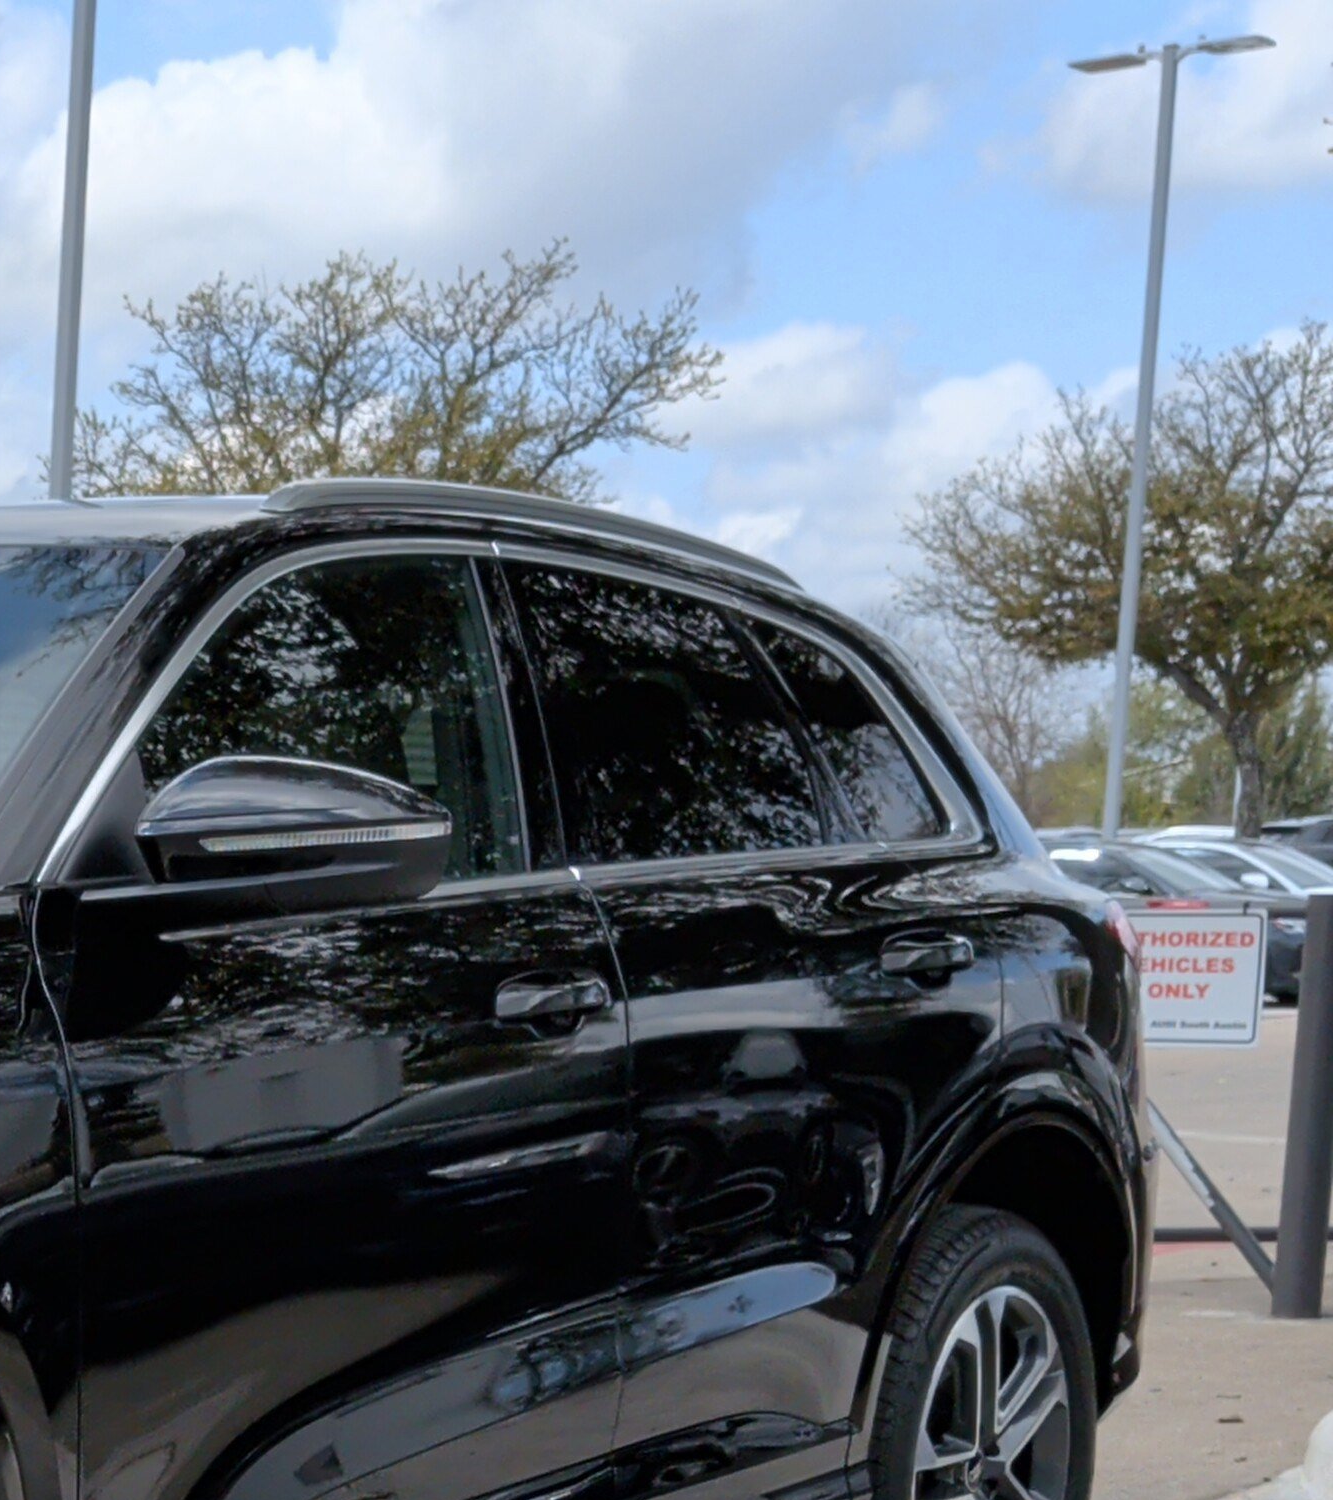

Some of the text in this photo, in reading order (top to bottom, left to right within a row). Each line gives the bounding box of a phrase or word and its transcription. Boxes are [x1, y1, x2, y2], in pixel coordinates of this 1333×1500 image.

[1137, 932, 1254, 947] THORIZED
[1140, 957, 1235, 973] EHICLES
[1148, 984, 1210, 999] ONLY
